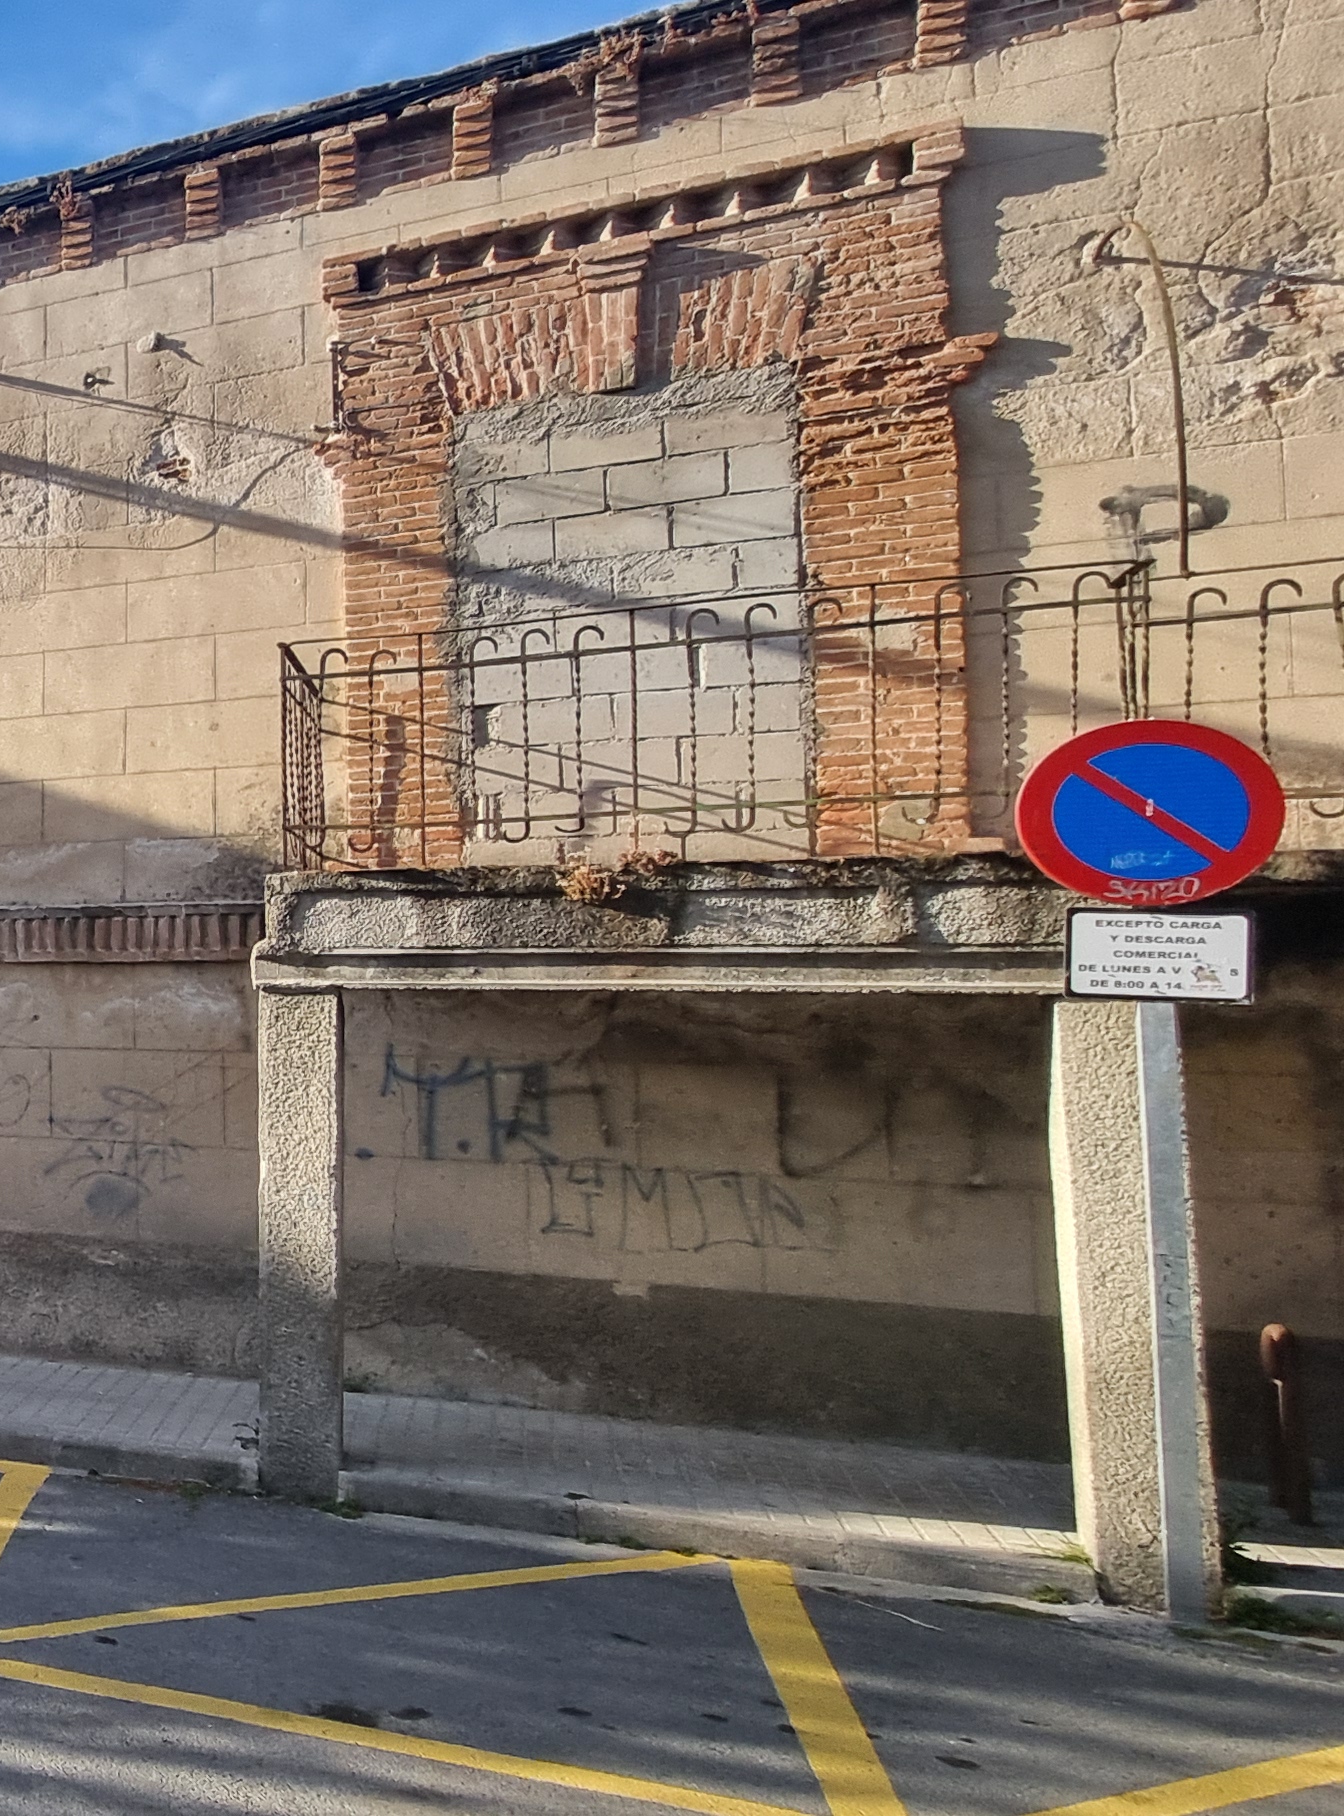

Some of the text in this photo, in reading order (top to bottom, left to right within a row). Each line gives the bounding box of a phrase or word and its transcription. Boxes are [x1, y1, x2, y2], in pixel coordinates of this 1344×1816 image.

[1095, 919, 1223, 930] EXCEPTO CARGA
[1110, 934, 1207, 945] Y DESCARGA
[1078, 964, 1099, 973] DE
[1102, 964, 1152, 974] LUNES
[1156, 966, 1167, 974] A
[1090, 979, 1109, 989] DE
[1149, 981, 1160, 990] A
